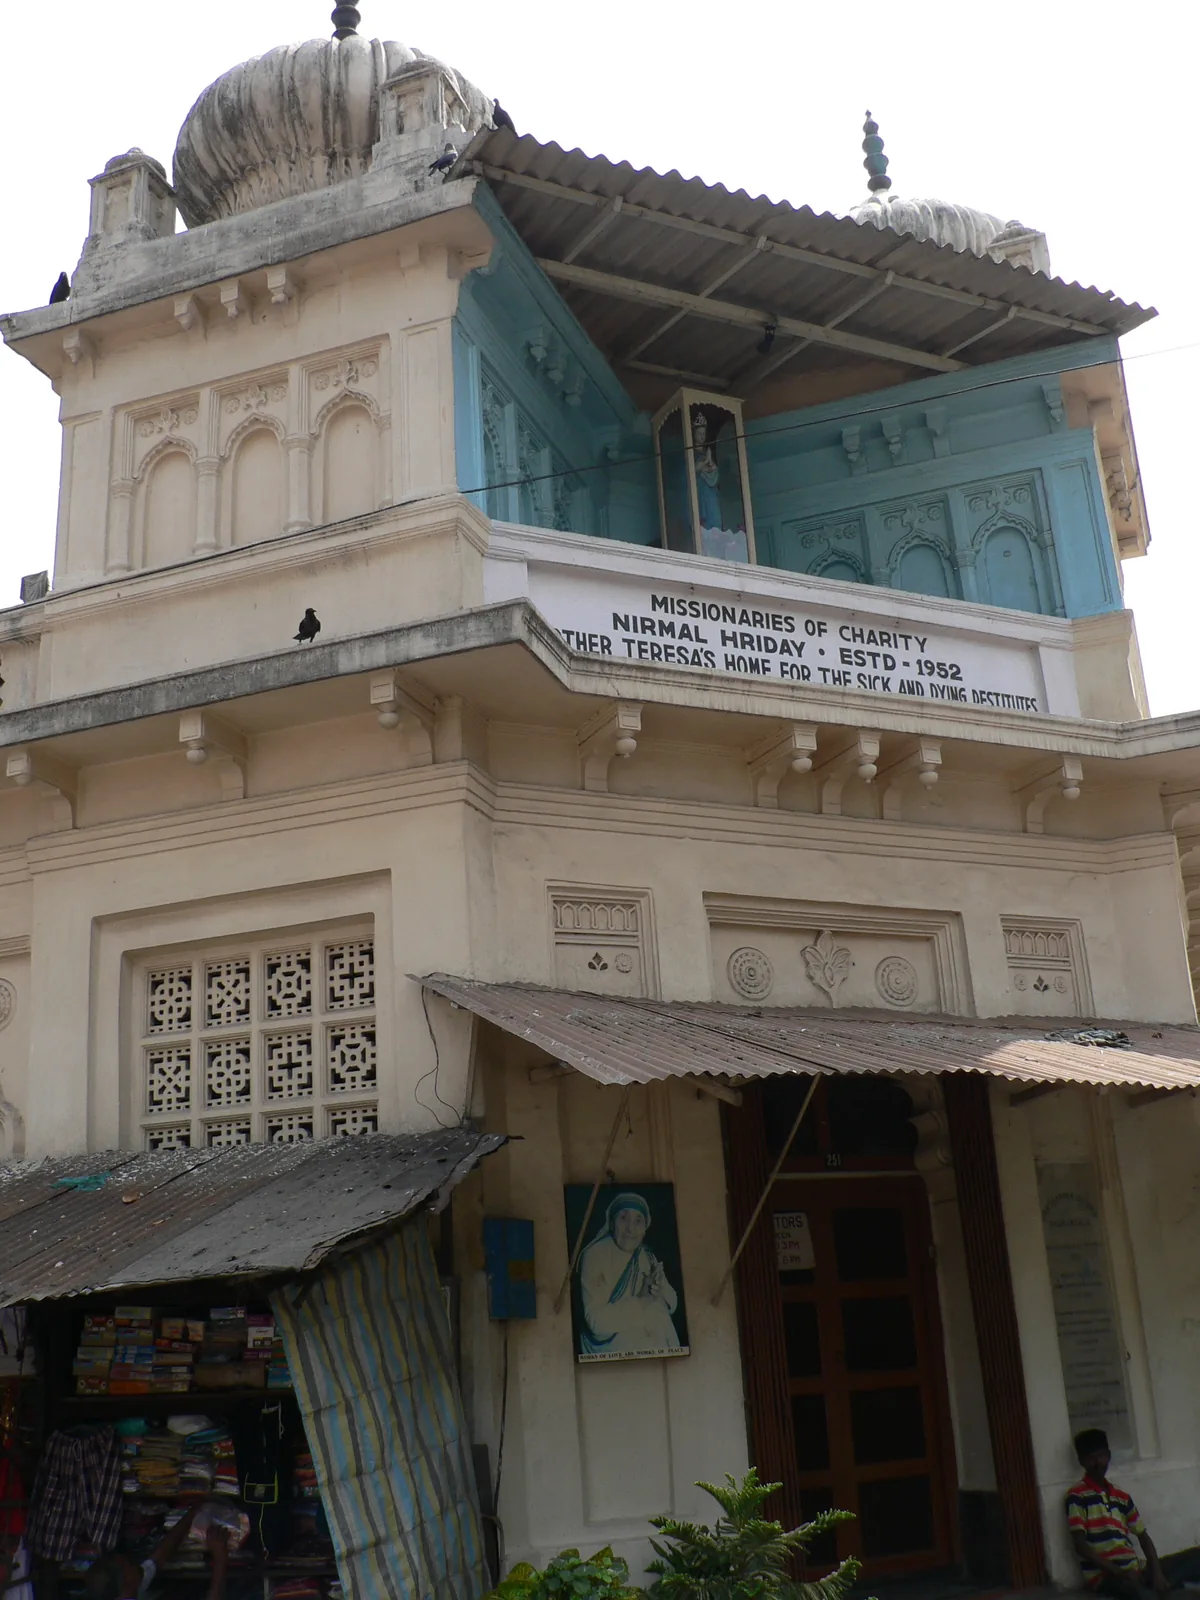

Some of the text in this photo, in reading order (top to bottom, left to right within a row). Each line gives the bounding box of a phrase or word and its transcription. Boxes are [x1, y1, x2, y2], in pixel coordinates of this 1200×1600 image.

[612, 612, 708, 645] NIRMAL
[720, 629, 806, 658] HRIDAY
[839, 647, 897, 672] ESTD
[915, 659, 964, 682] 1952
[651, 594, 928, 653] MISSIONARIES OF CHARITY
[554, 628, 612, 656] THER
[622, 637, 717, 669] TERESA'S
[724, 653, 772, 676] HOME
[780, 661, 812, 682] FOR
[817, 667, 853, 687] THE
[857, 672, 892, 693] SICK
[898, 678, 925, 697] AND
[930, 682, 968, 703] DYING
[774, 1216, 803, 1229] TORS
